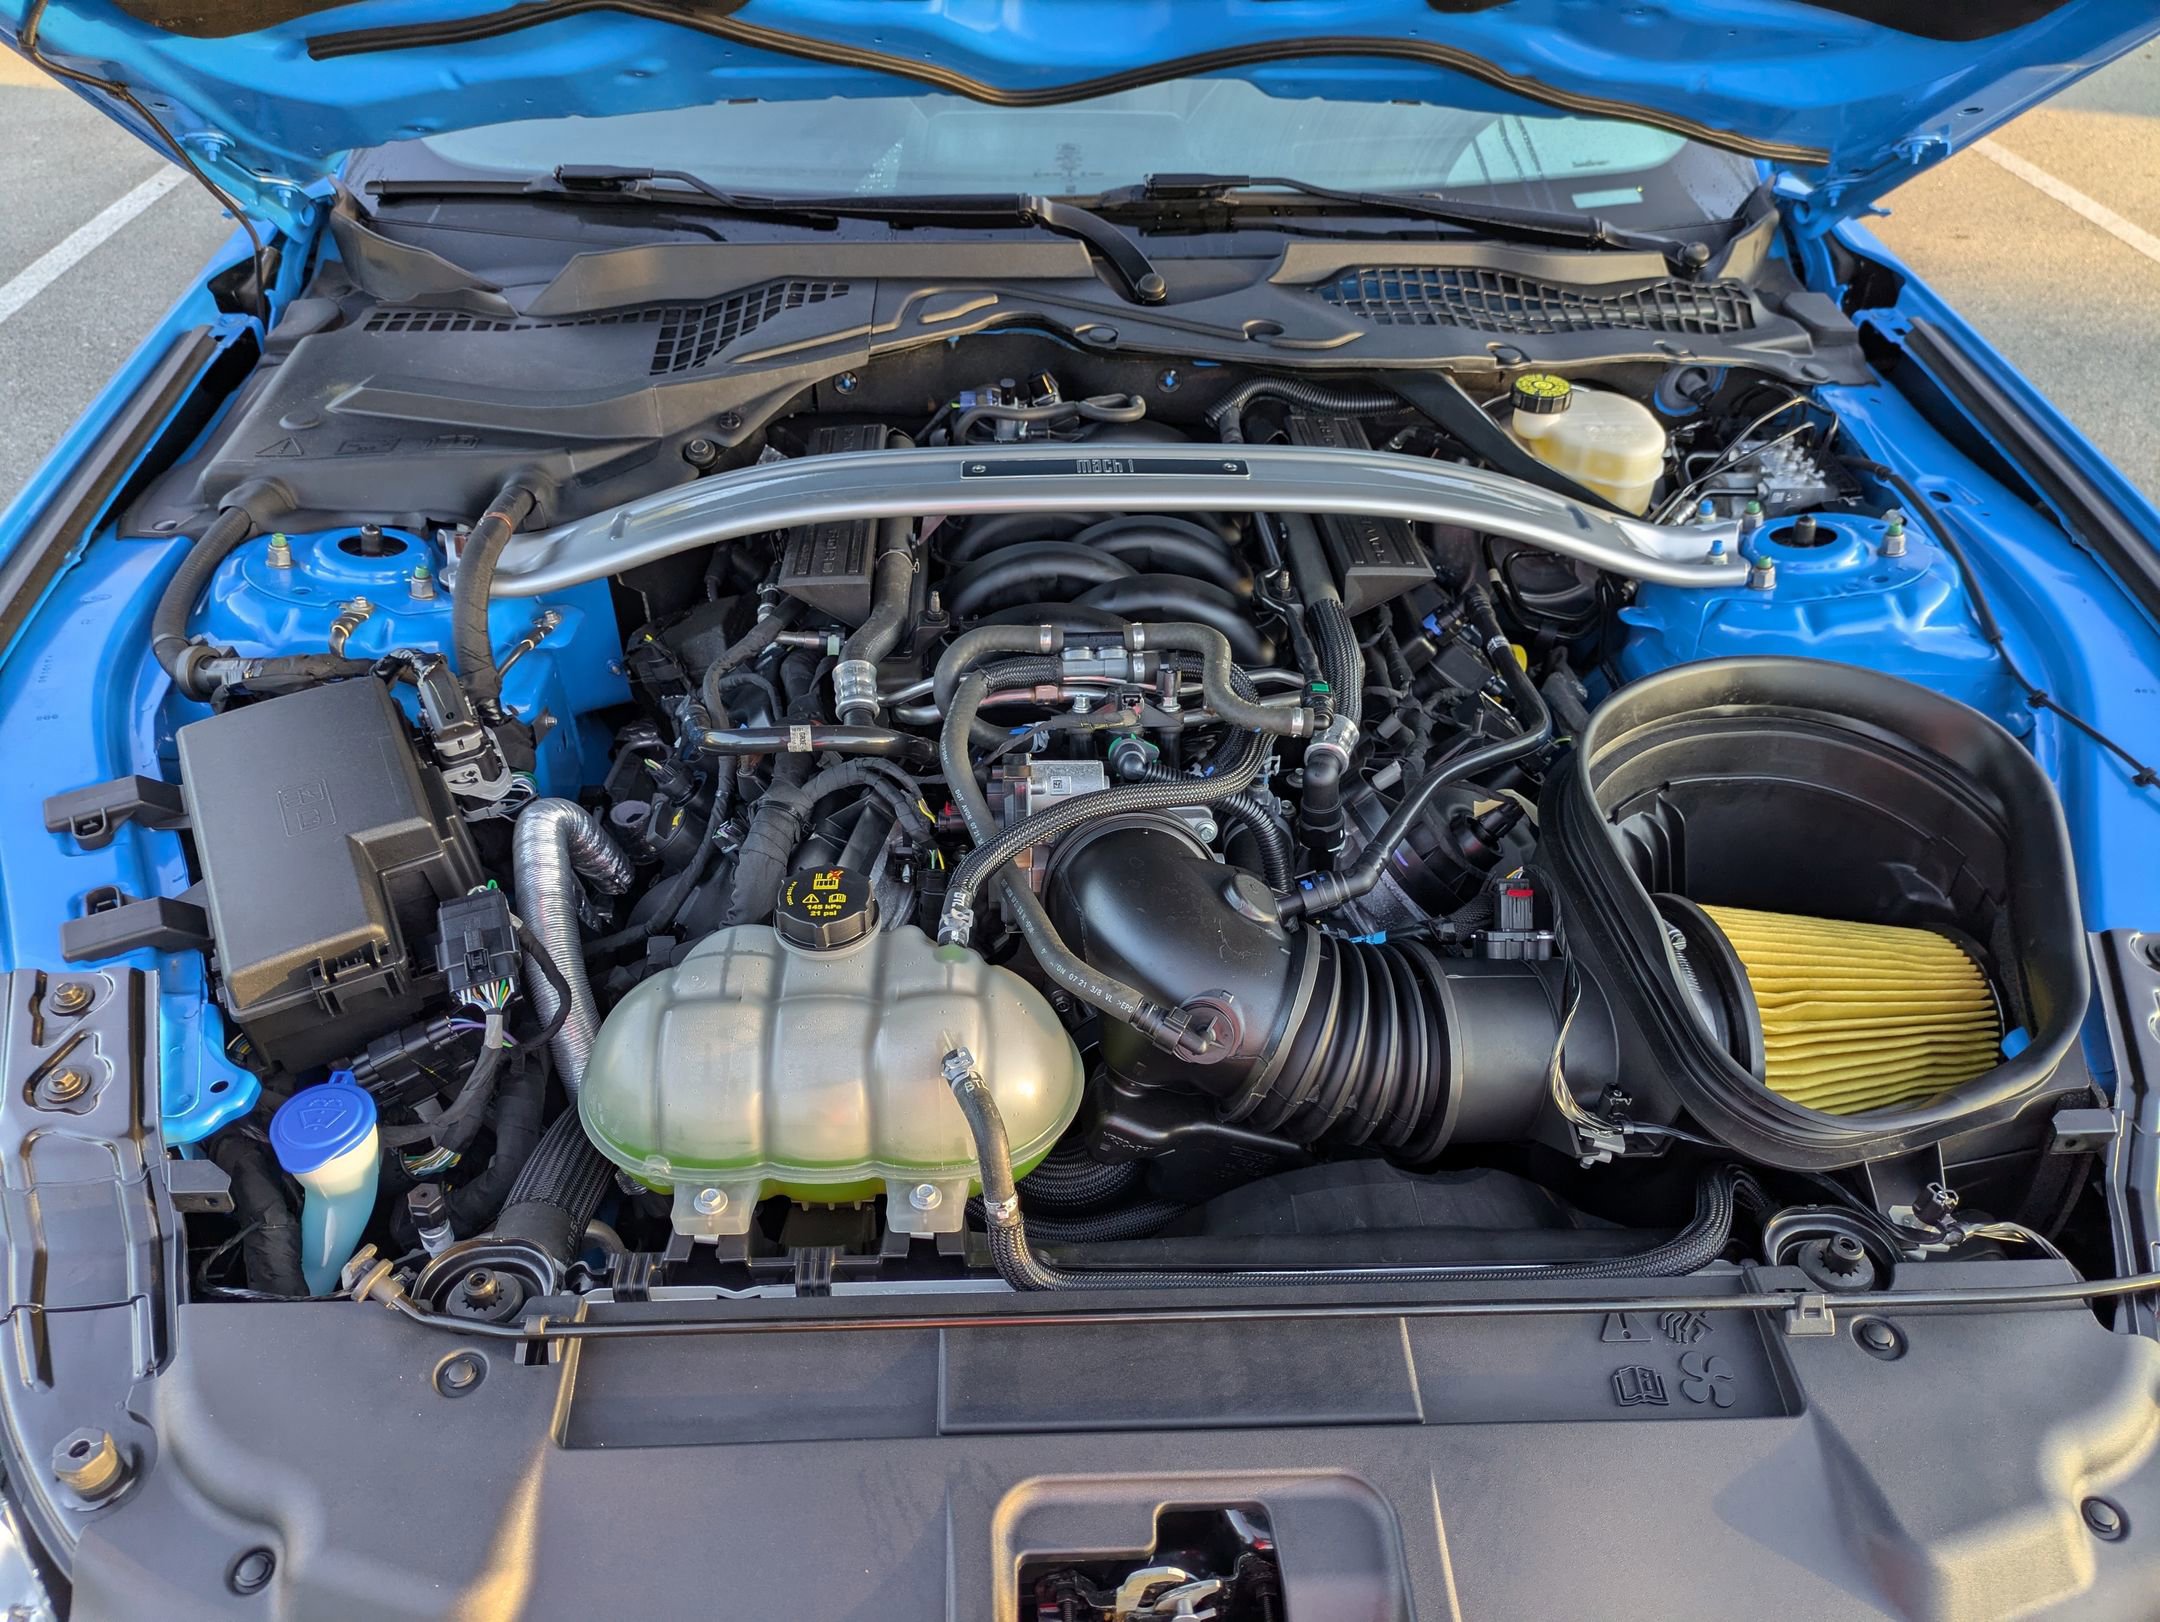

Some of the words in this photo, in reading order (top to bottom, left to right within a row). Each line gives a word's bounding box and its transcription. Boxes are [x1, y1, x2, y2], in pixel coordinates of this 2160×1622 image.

[1076, 459, 1123, 473] mach
[1128, 458, 1135, 473] 1
[1068, 972, 1078, 982] 07
[1078, 979, 1087, 989] 21
[1089, 985, 1102, 996] 3/8
